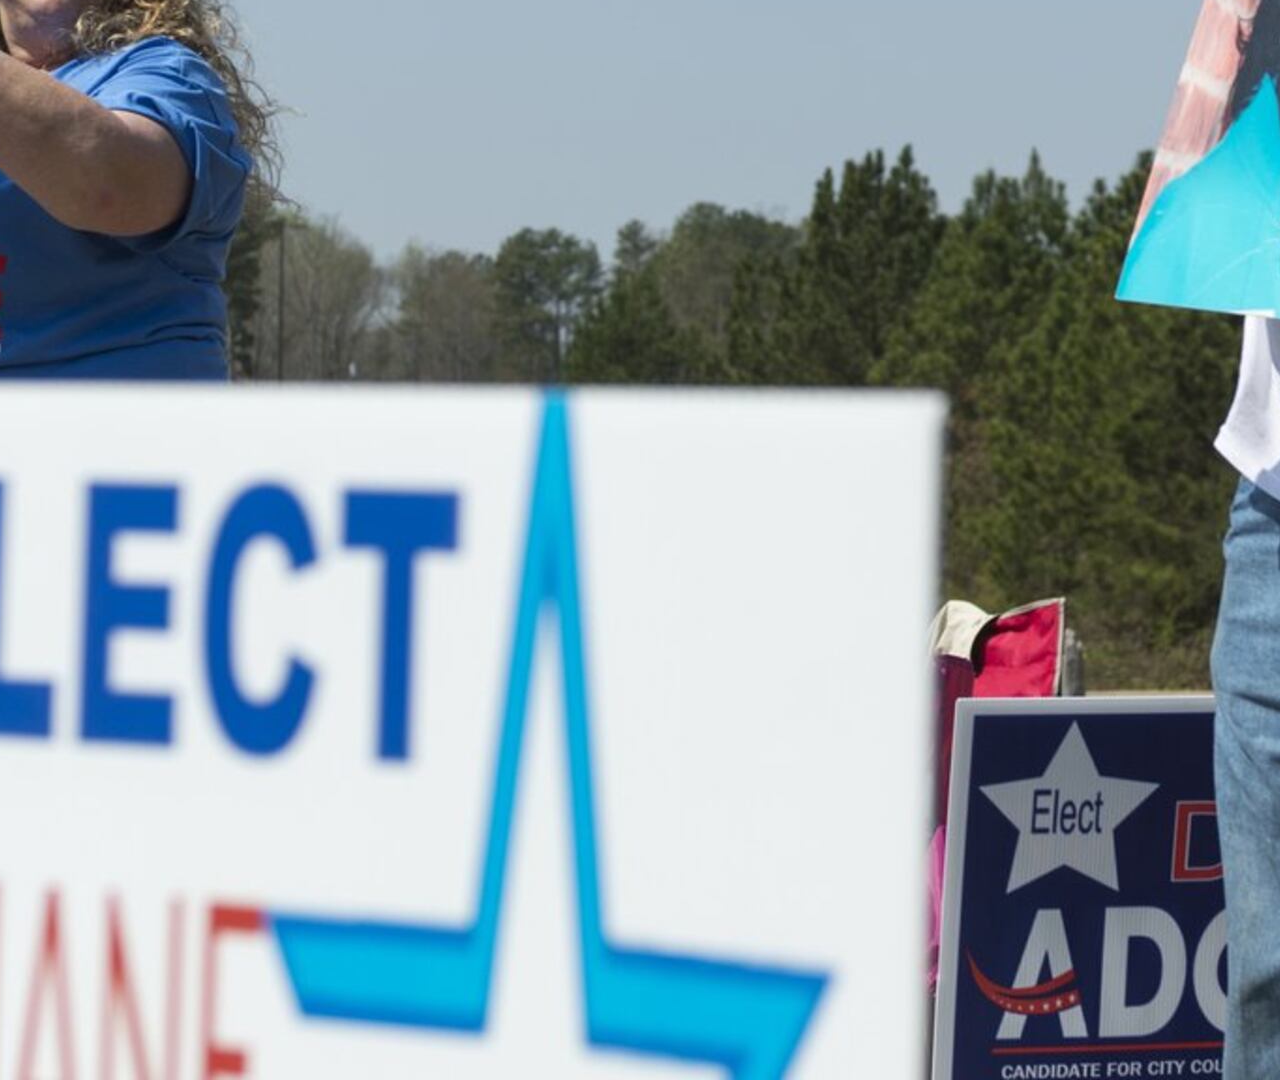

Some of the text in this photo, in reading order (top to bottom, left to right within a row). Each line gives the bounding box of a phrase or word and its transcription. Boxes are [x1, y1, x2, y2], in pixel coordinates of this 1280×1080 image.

[1031, 788, 1103, 835] Elect
[1001, 1063, 1101, 1080] CANDIDATE
[1107, 1061, 1142, 1077] FOR
[1147, 1060, 1186, 1076] CITY
